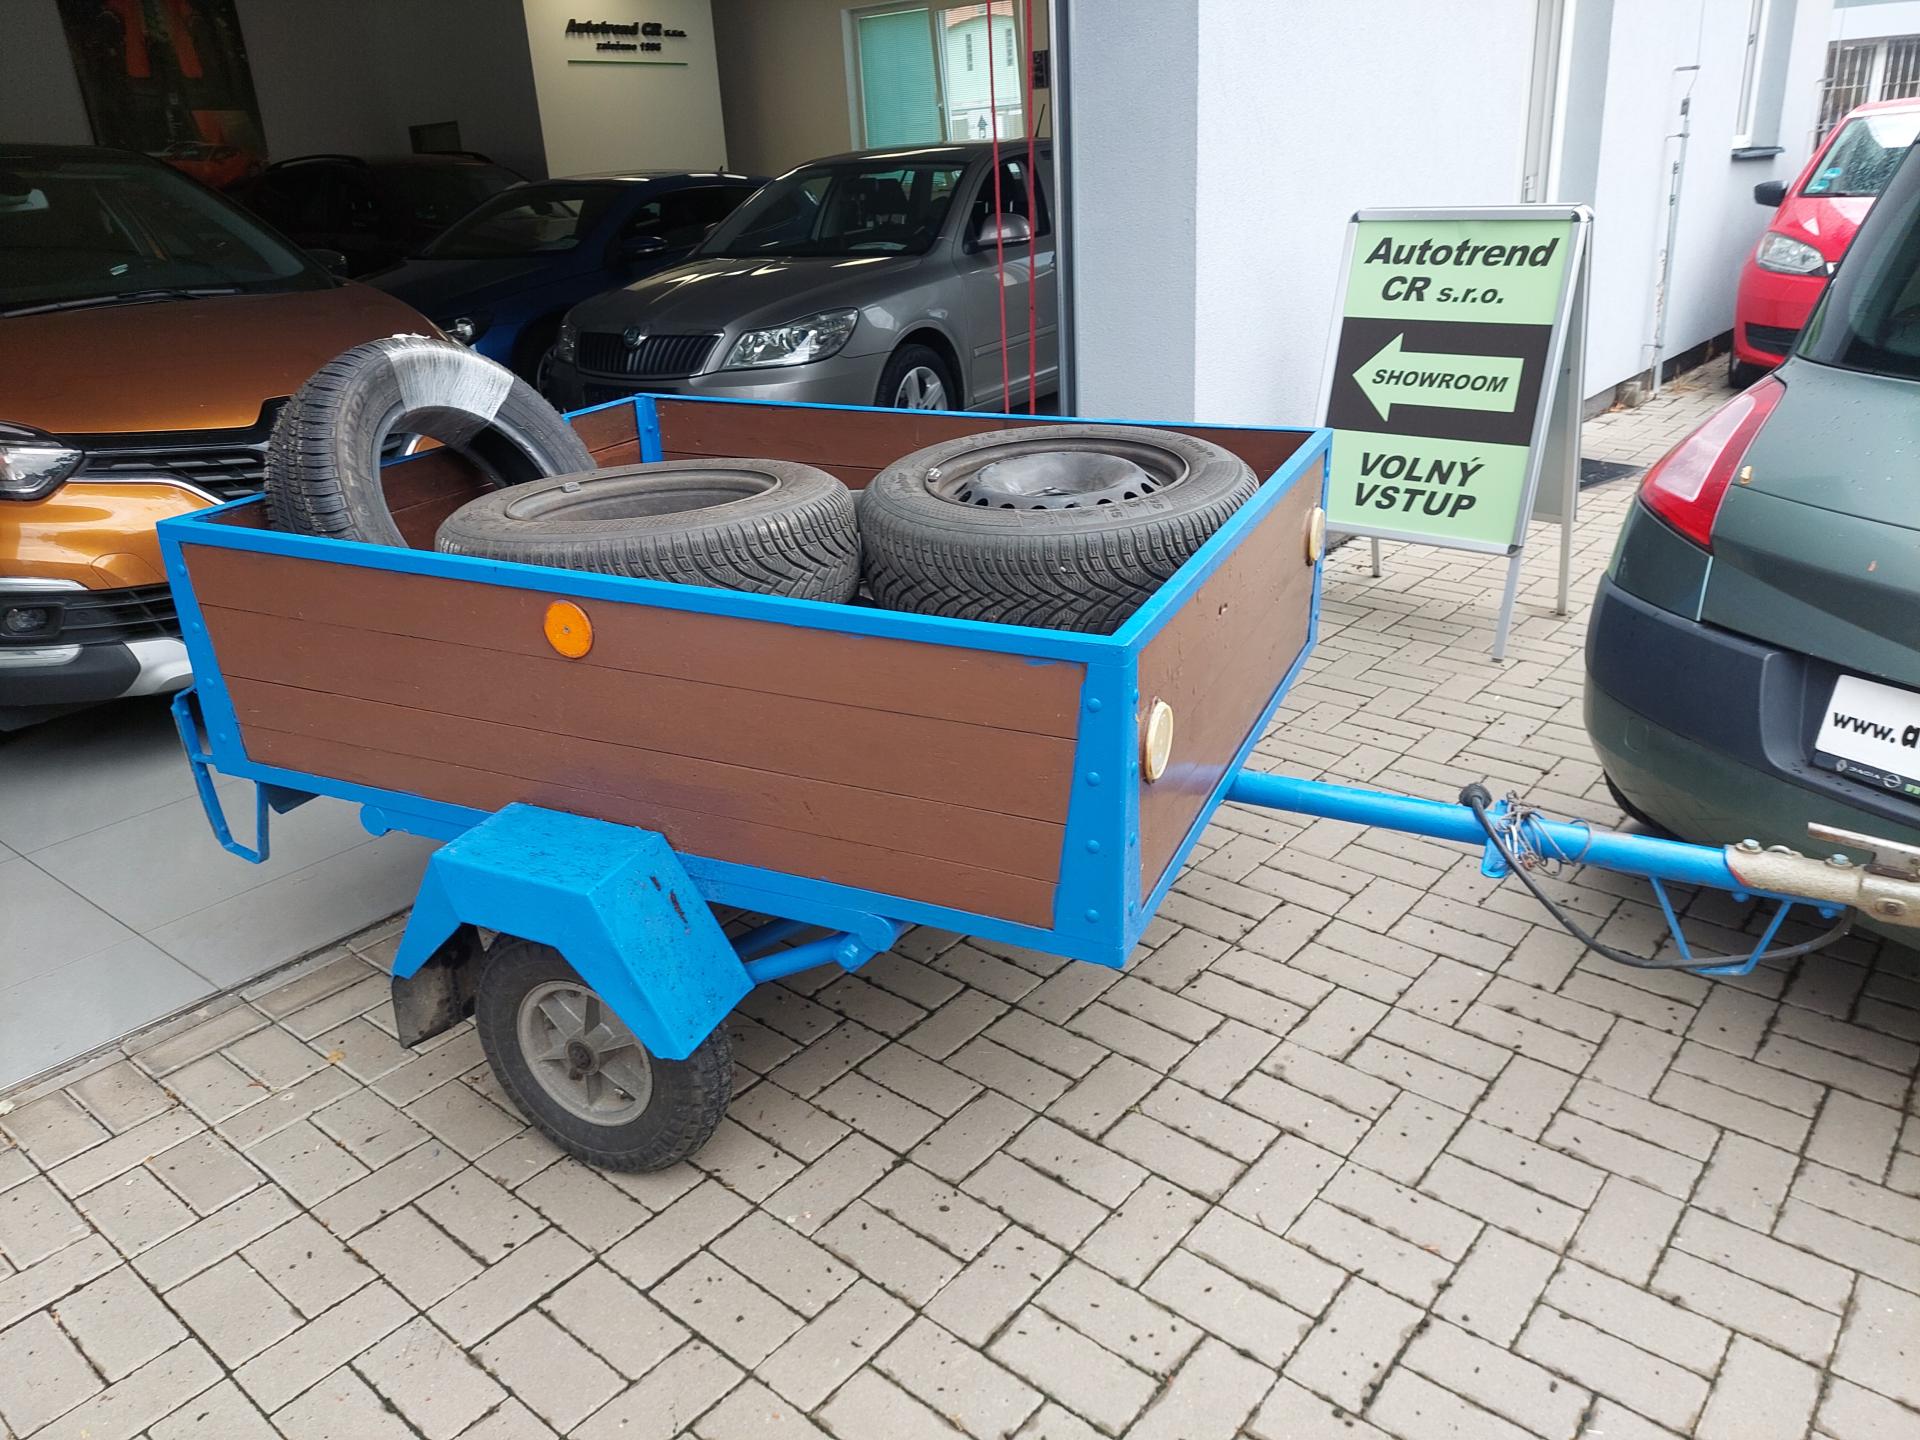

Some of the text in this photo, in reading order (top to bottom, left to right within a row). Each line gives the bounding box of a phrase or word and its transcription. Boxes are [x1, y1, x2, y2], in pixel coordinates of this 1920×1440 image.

[565, 18, 639, 35] Autotrend
[1364, 237, 1560, 267] Autotrend
[1381, 276, 1504, 304] CR s.r.o.
[1371, 368, 1509, 393] SHOWROOM
[1360, 451, 1485, 487] VOLNÝ
[1354, 482, 1477, 518] VSTUP
